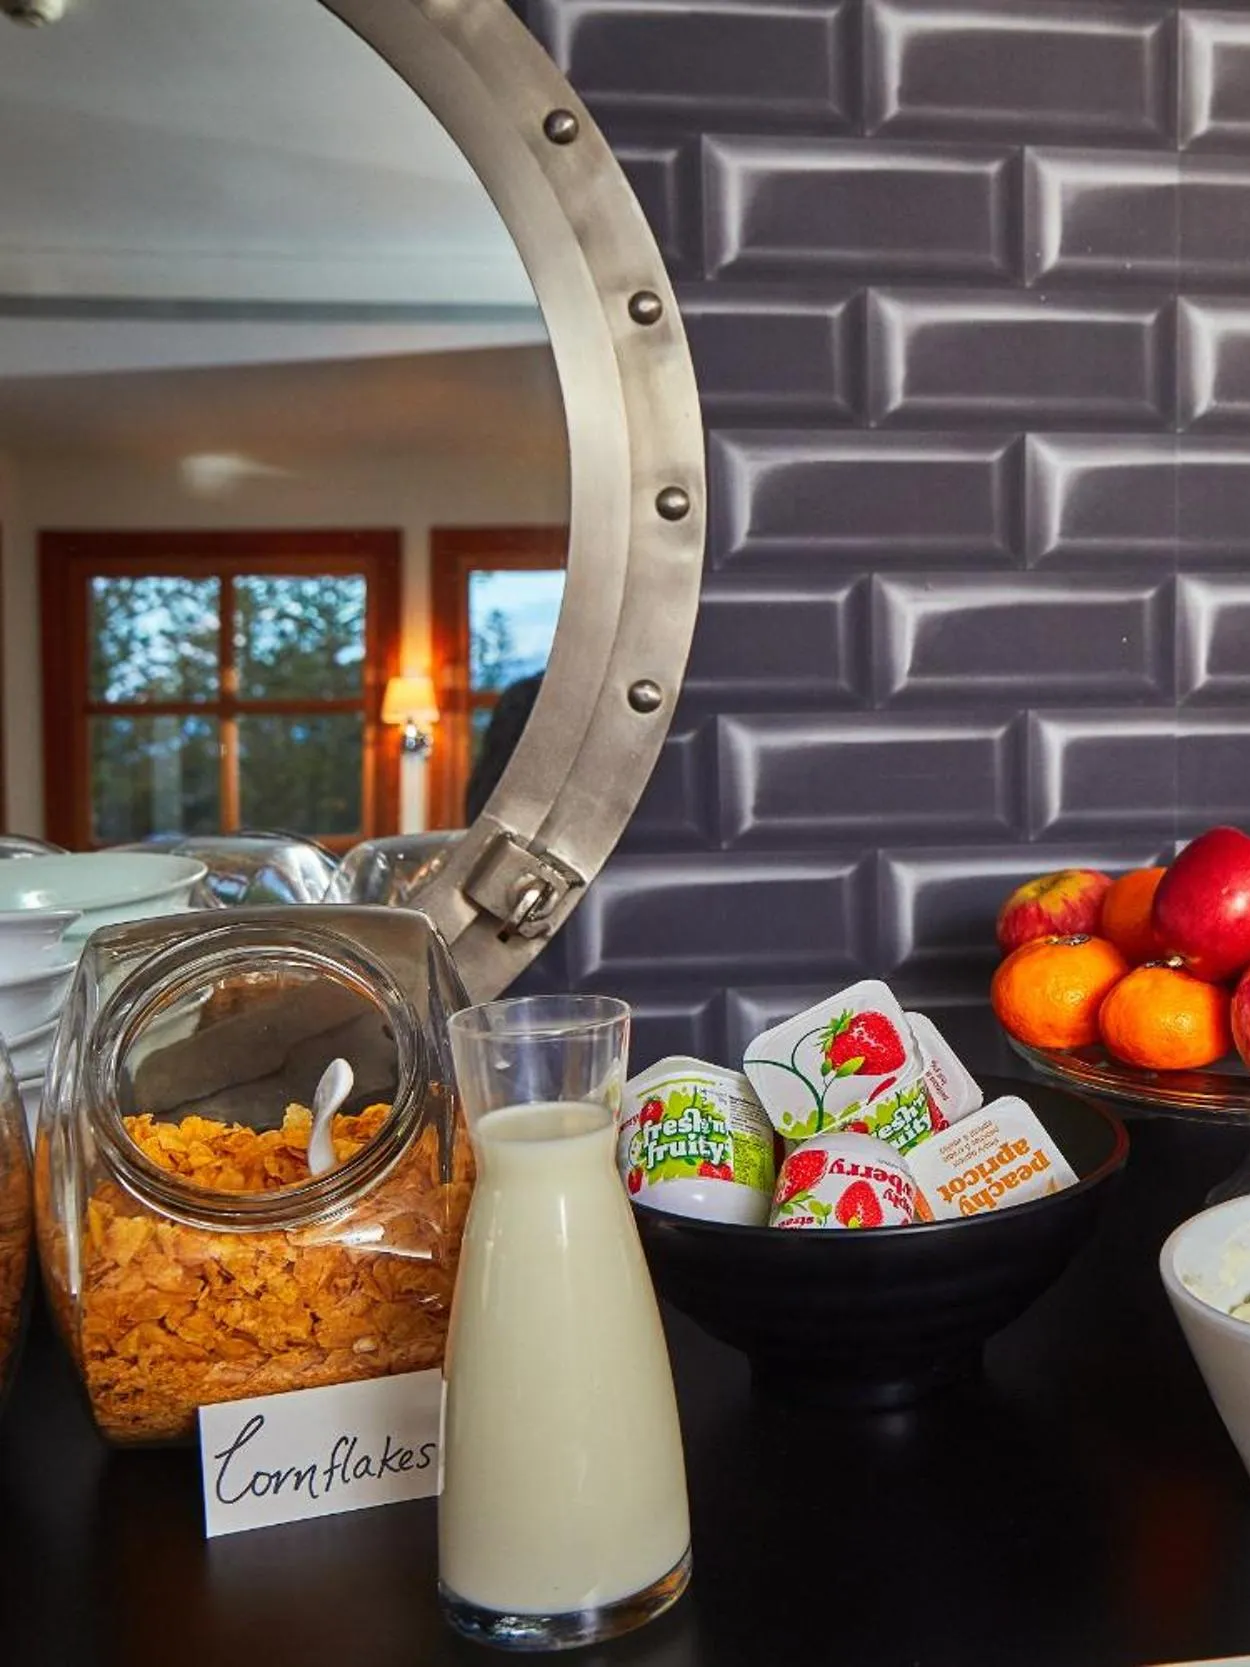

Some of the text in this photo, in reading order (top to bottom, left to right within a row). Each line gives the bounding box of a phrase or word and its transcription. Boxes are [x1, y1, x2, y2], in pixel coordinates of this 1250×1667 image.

[646, 1132, 725, 1169] fruity
[936, 1137, 1031, 1204] apricot
[959, 1148, 1052, 1217] peachy
[214, 1413, 437, 1505] Cornflakes
